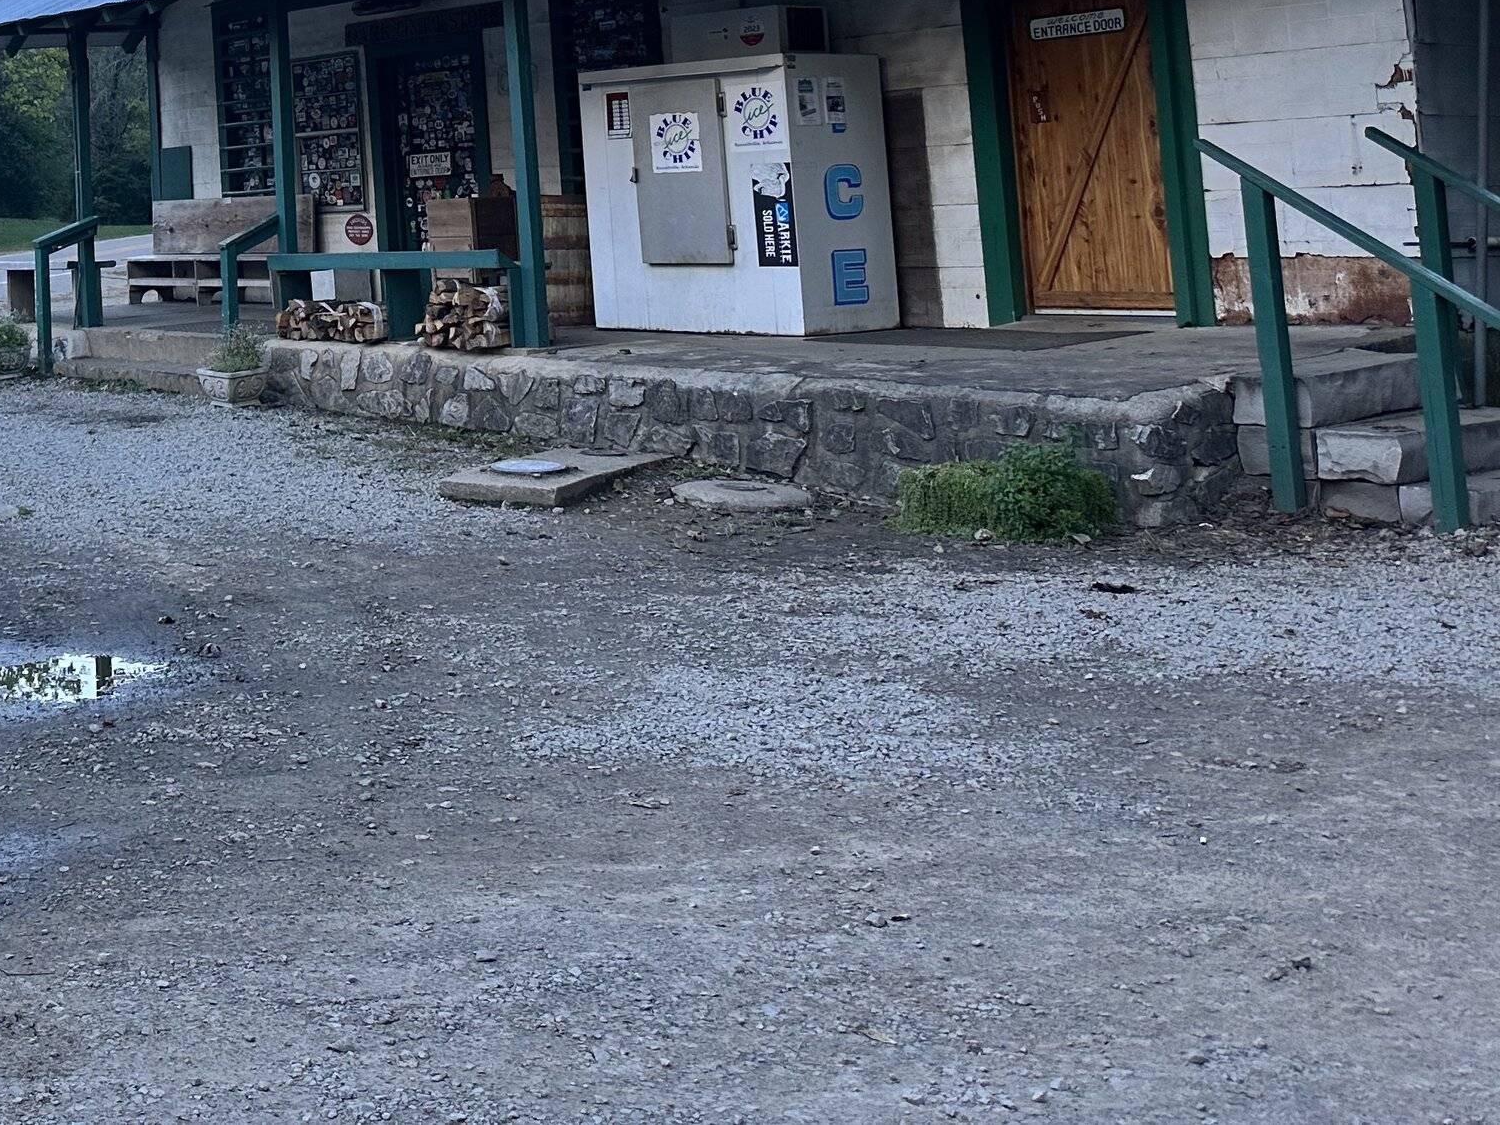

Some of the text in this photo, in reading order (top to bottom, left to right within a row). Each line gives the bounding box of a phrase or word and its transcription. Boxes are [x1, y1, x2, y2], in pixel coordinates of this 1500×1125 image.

[1033, 17, 1122, 38] ENTRANCE DOOR
[734, 87, 774, 114] BLUE
[1032, 95, 1046, 122] PUSH
[656, 114, 692, 138] BLUE
[743, 103, 774, 125] ice
[741, 114, 778, 140] CHIP
[664, 129, 692, 150] ice
[411, 154, 448, 165] EXIT ONLY
[662, 140, 695, 164] CHIP
[762, 209, 776, 258] SOLD HERE
[777, 222, 792, 265] ARKIE
